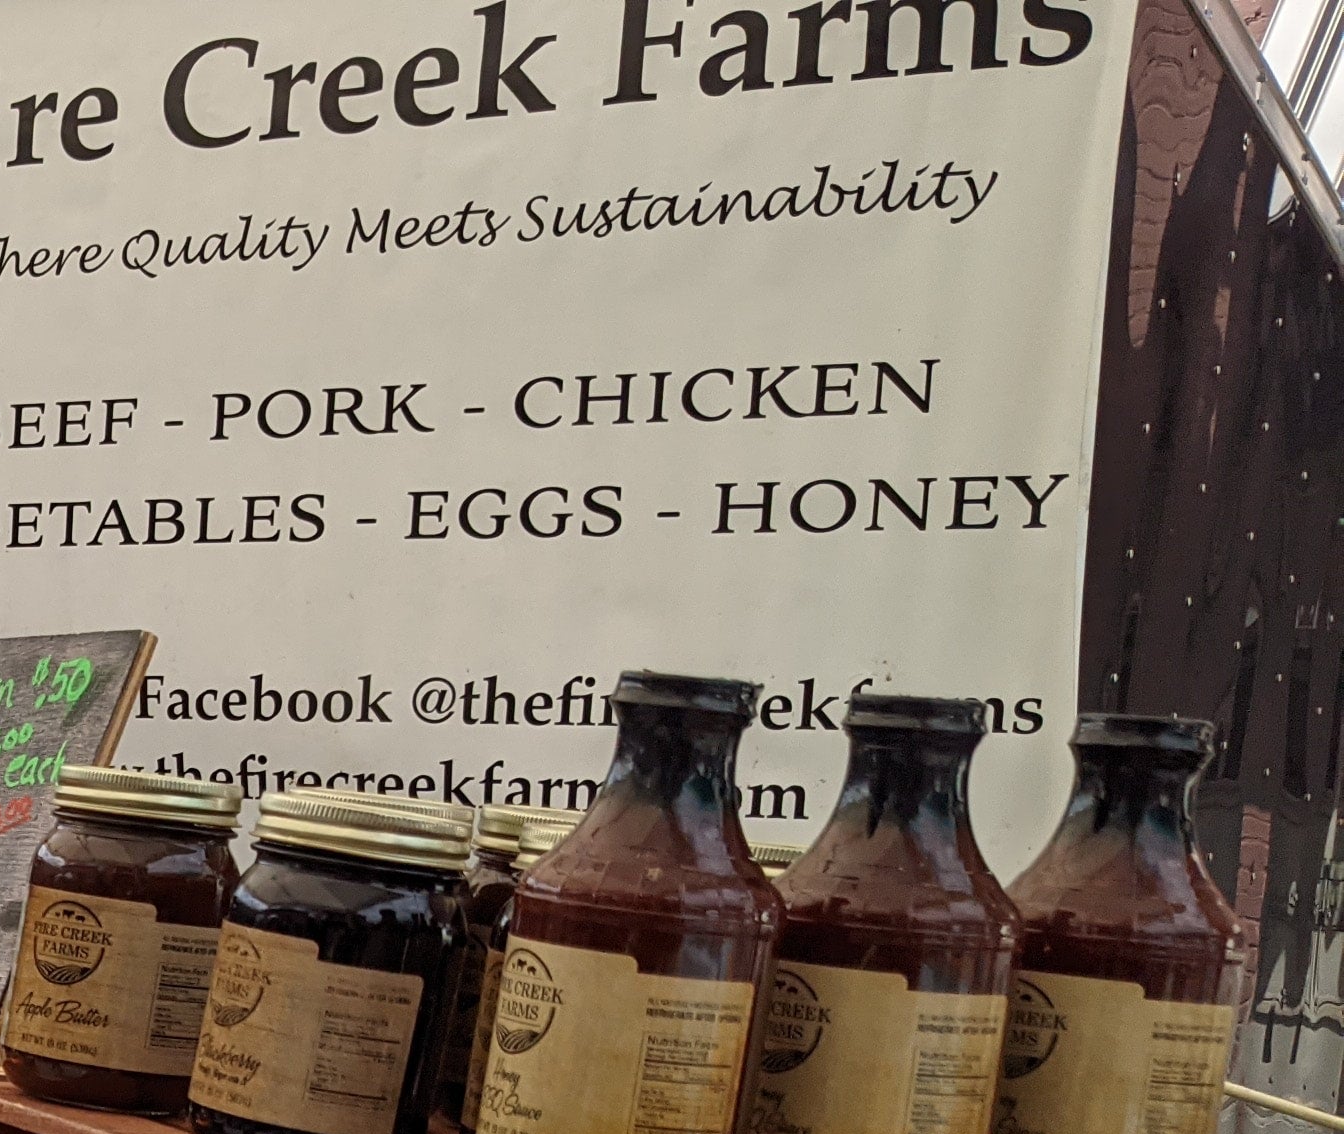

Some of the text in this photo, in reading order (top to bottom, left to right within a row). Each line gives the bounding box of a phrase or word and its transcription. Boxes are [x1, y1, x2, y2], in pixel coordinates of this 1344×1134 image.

[162, 0, 558, 149] Creek
[602, 0, 1094, 106] Farms
[121, 214, 330, 271] Quality
[345, 200, 510, 254] Meets
[516, 158, 999, 244] Sustainability
[209, 382, 435, 441] PORK
[514, 358, 941, 430] CHICKEN
[404, 485, 623, 541] EGGS
[711, 473, 1069, 535] HONEY
[134, 673, 393, 724] Facebook
[42, 939, 90, 960] FARMS
[61, 924, 113, 946] CREEK
[15, 991, 111, 1028] Apple Butter
[500, 999, 539, 1020] FARMS
[514, 980, 564, 1005] CREEK
